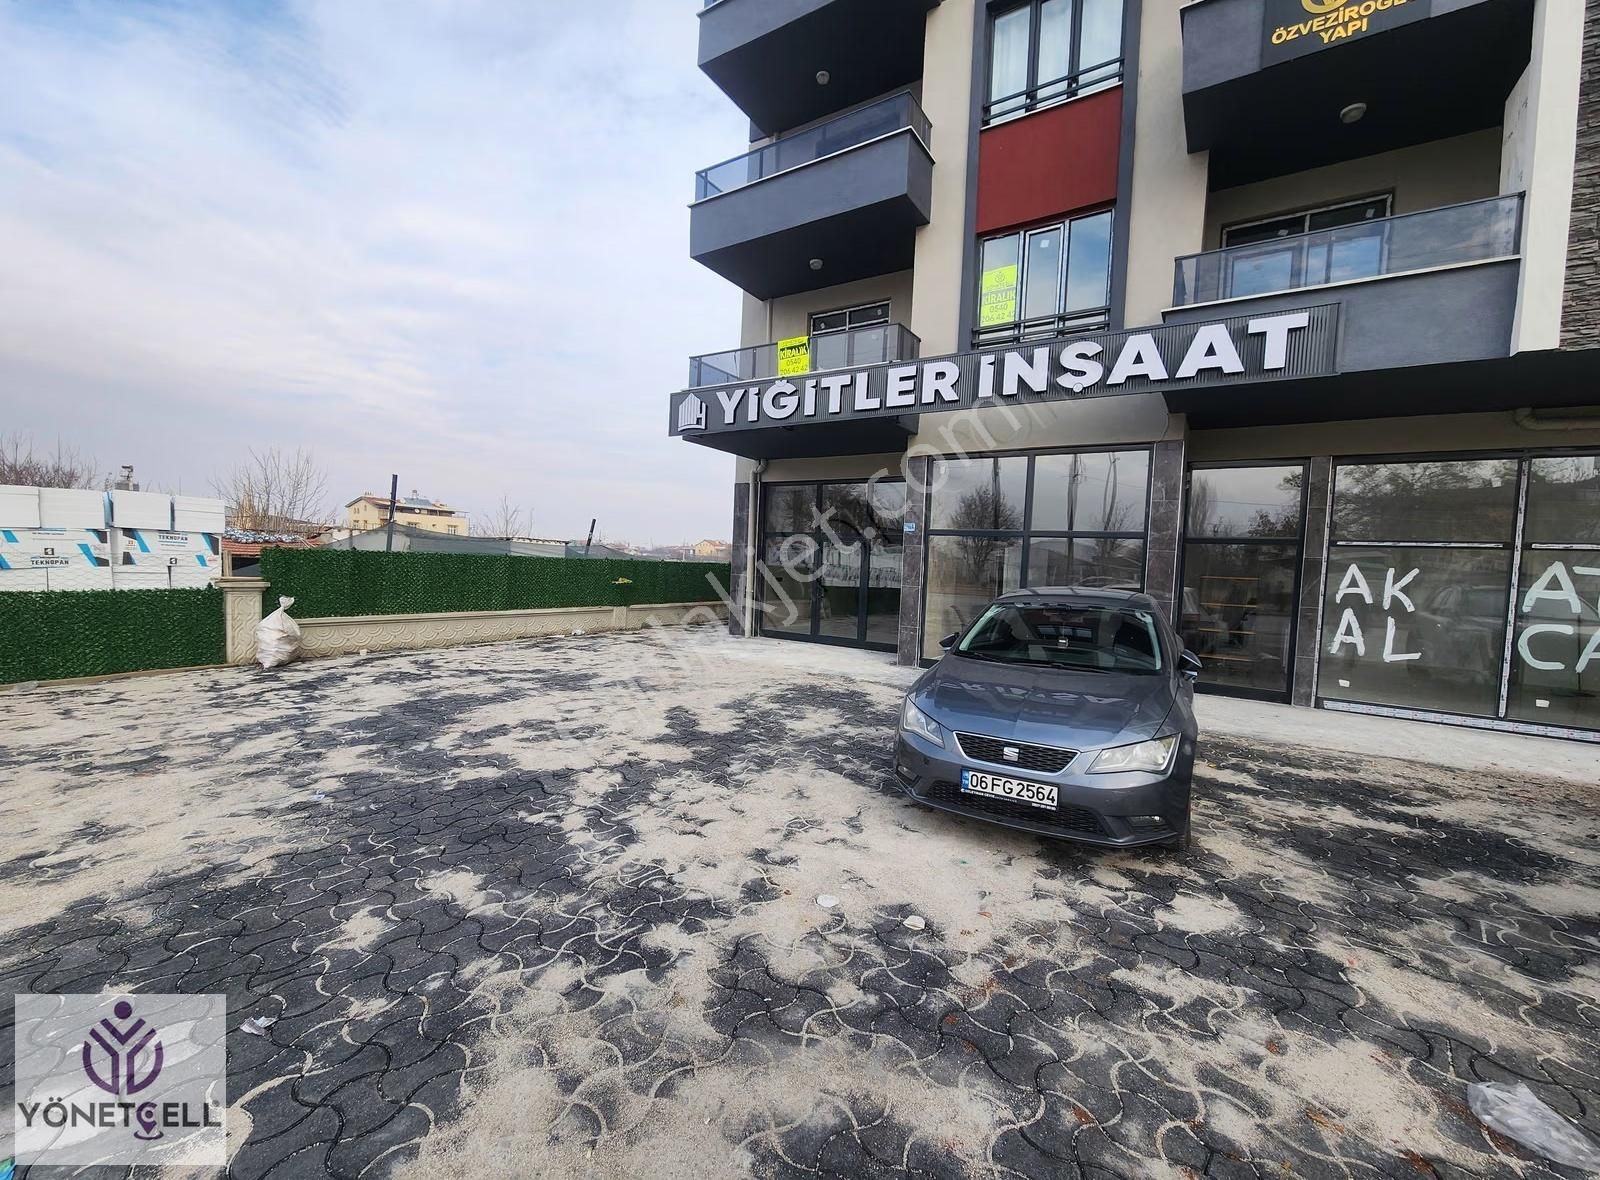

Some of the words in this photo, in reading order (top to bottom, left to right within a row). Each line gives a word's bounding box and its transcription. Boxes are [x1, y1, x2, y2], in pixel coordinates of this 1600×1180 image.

[1319, 17, 1369, 44] YAPI
[716, 361, 960, 424] YİĞİTLER
[978, 312, 1309, 398] İNŞAAT
[779, 344, 807, 361] KİRALIK
[1335, 563, 1420, 612] AK
[1328, 607, 1422, 662] AL
